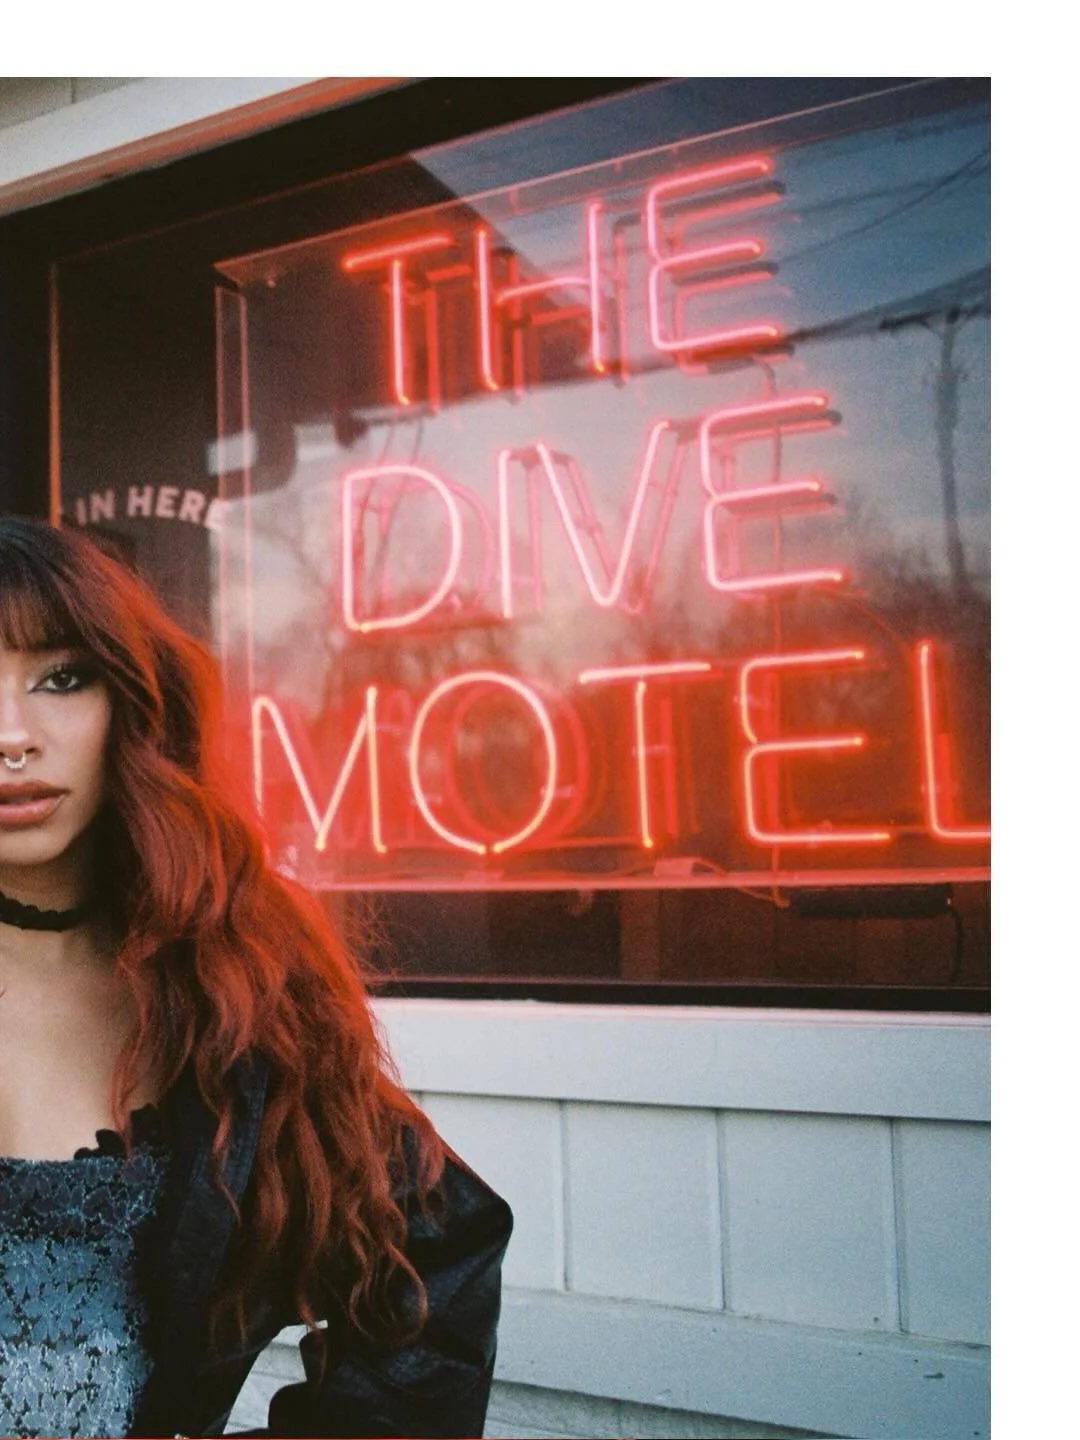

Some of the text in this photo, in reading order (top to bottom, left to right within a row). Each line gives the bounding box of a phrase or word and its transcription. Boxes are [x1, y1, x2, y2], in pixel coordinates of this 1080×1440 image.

[342, 155, 784, 408] THE
[76, 485, 232, 530] IN HERE
[338, 392, 848, 634] DIVE
[250, 638, 991, 854] MOTEL
